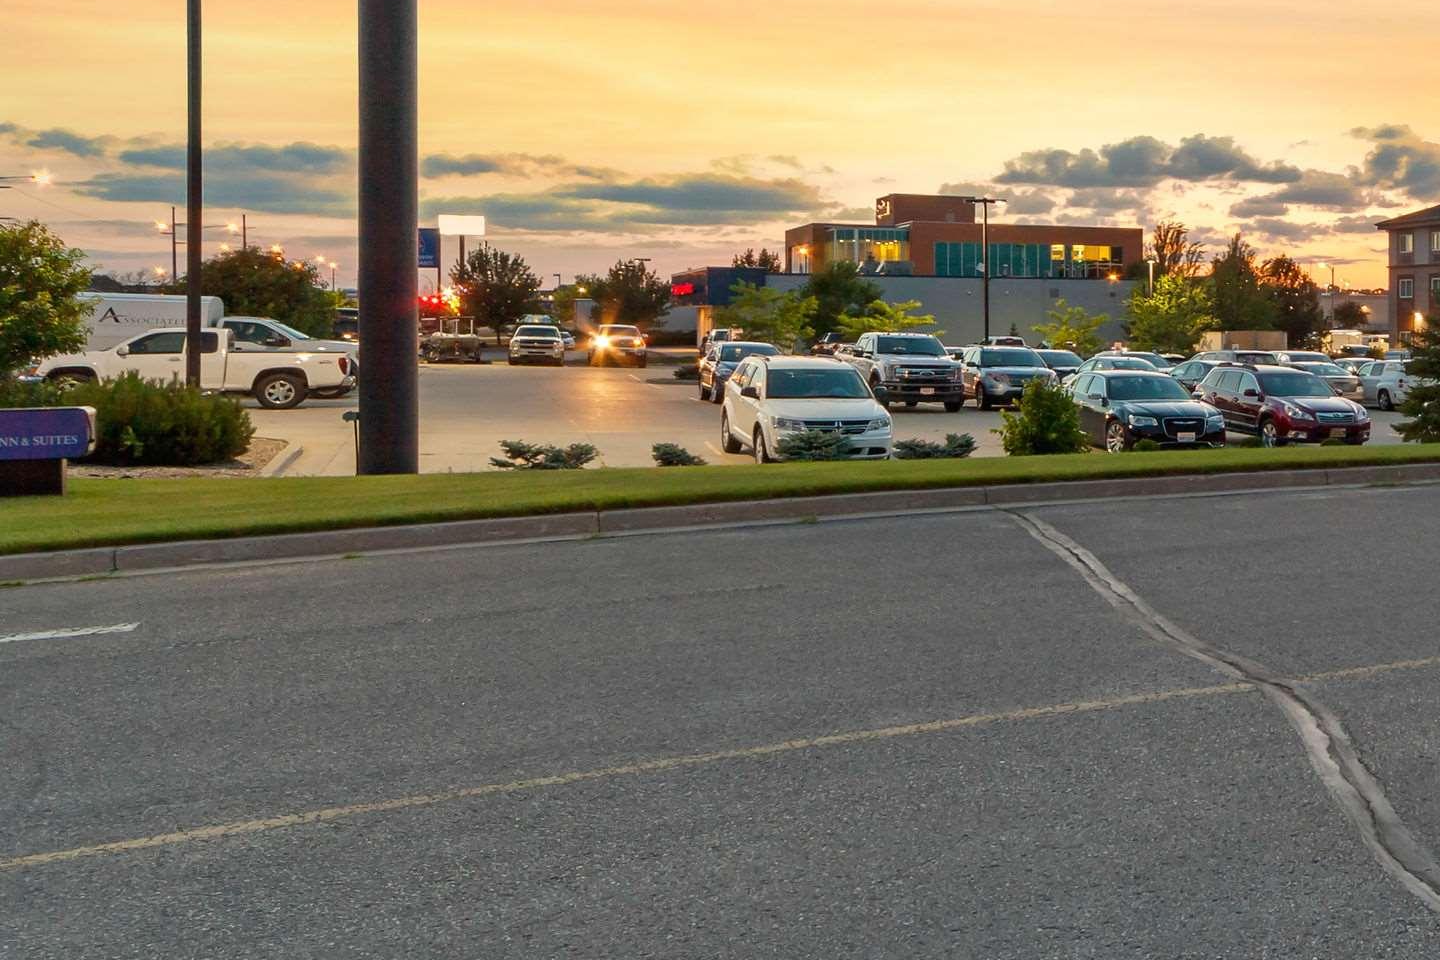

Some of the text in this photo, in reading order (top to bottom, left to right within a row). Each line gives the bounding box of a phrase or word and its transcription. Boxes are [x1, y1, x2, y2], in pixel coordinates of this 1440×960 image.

[0, 435, 79, 447] NN & SUITES
